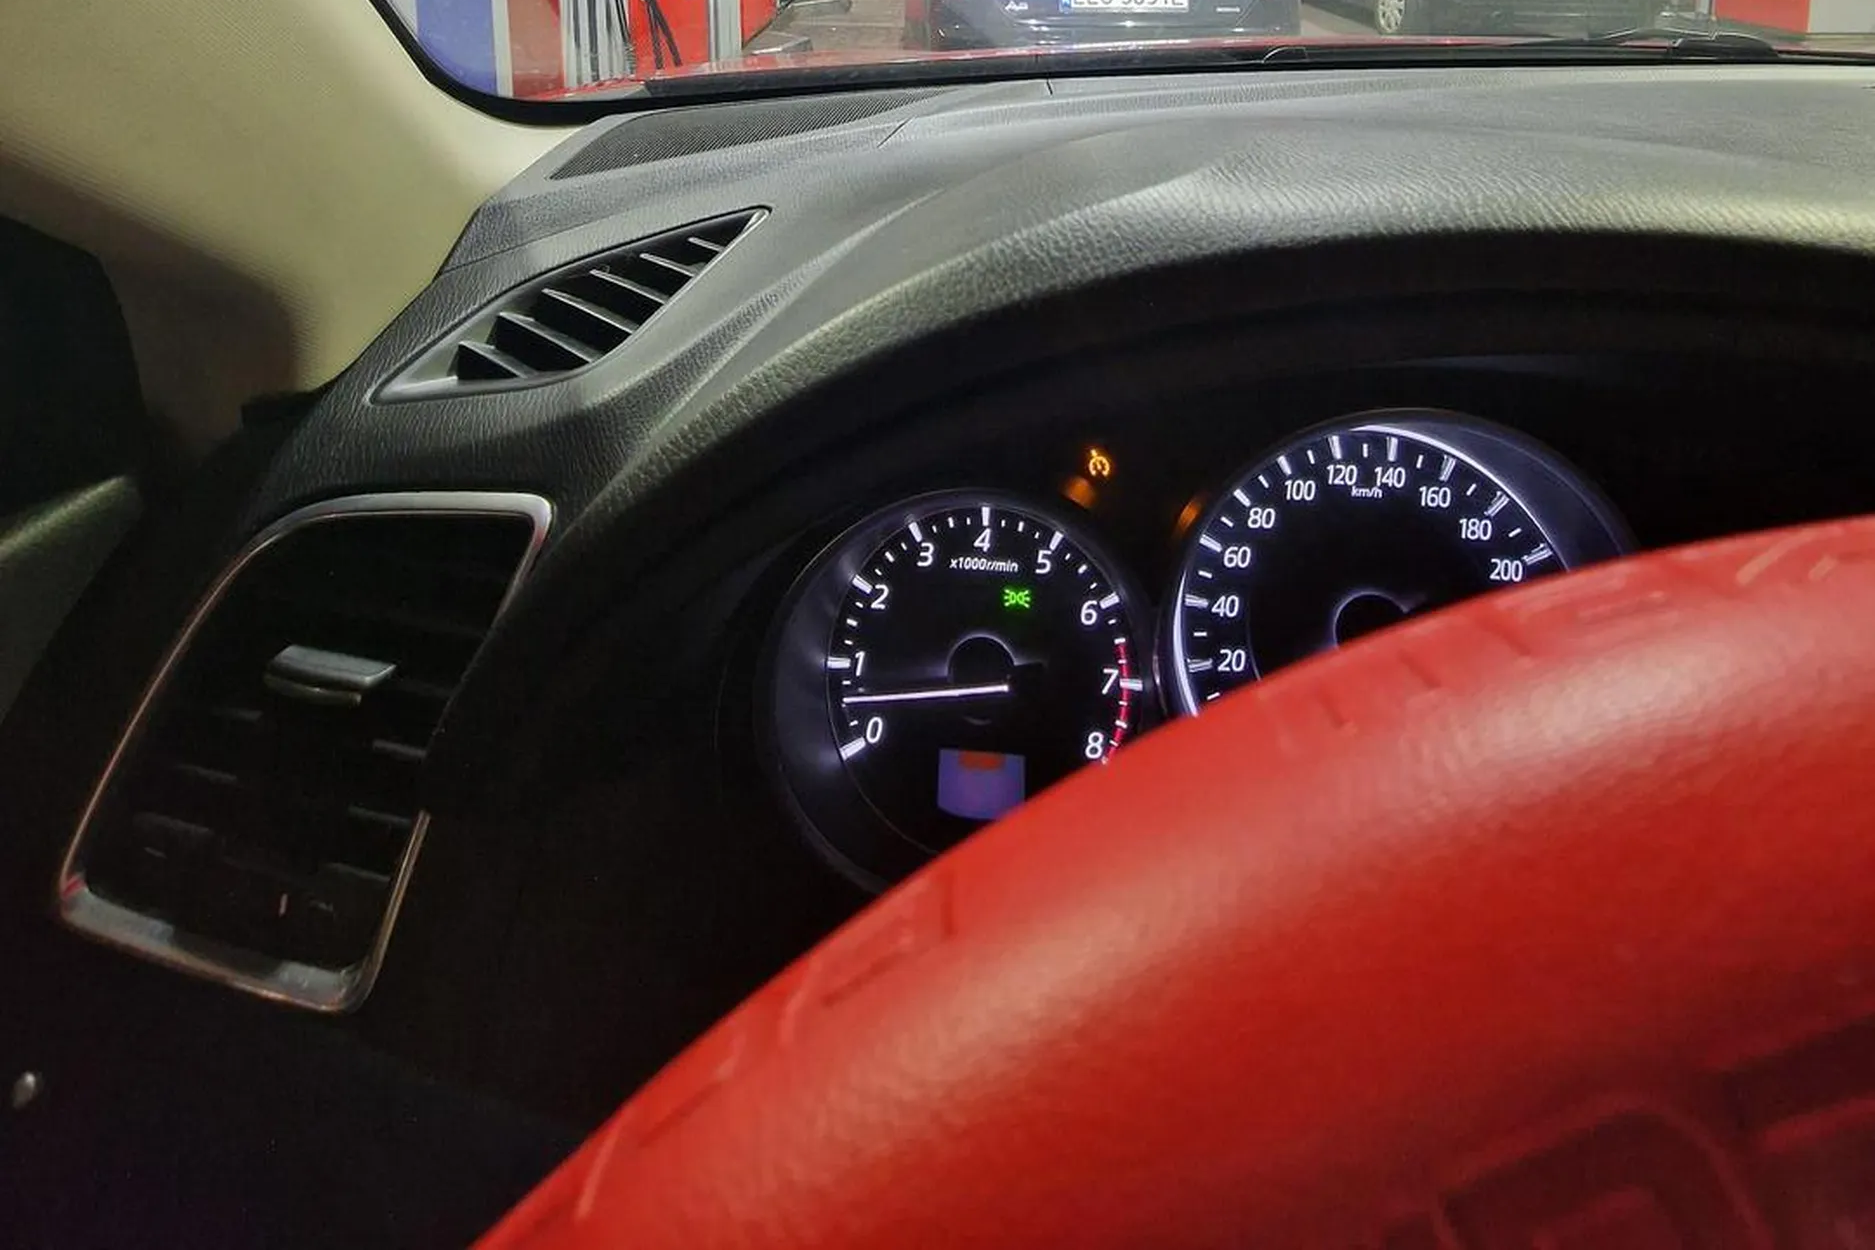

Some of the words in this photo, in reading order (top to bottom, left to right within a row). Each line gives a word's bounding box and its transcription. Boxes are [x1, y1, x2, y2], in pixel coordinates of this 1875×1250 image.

[1326, 464, 1358, 486] 120
[1374, 466, 1406, 488] 140
[1284, 479, 1316, 501] 100
[1350, 485, 1383, 499] km/h
[1419, 486, 1452, 508] 160
[1247, 507, 1277, 529] 80
[1459, 518, 1493, 541] 180
[973, 528, 992, 553] 4
[916, 542, 935, 568] 3
[949, 555, 1019, 573] x1000r/min
[1034, 549, 1054, 575] 5
[1222, 546, 1252, 569] 60
[1489, 558, 1524, 583] 200
[870, 584, 890, 610] 2
[1211, 595, 1240, 618] 40
[1080, 600, 1098, 626] 6
[854, 651, 866, 677] 1
[1217, 649, 1247, 672] 20
[1102, 668, 1120, 695] 7
[866, 717, 884, 745] 0
[1085, 732, 1105, 760] 8
